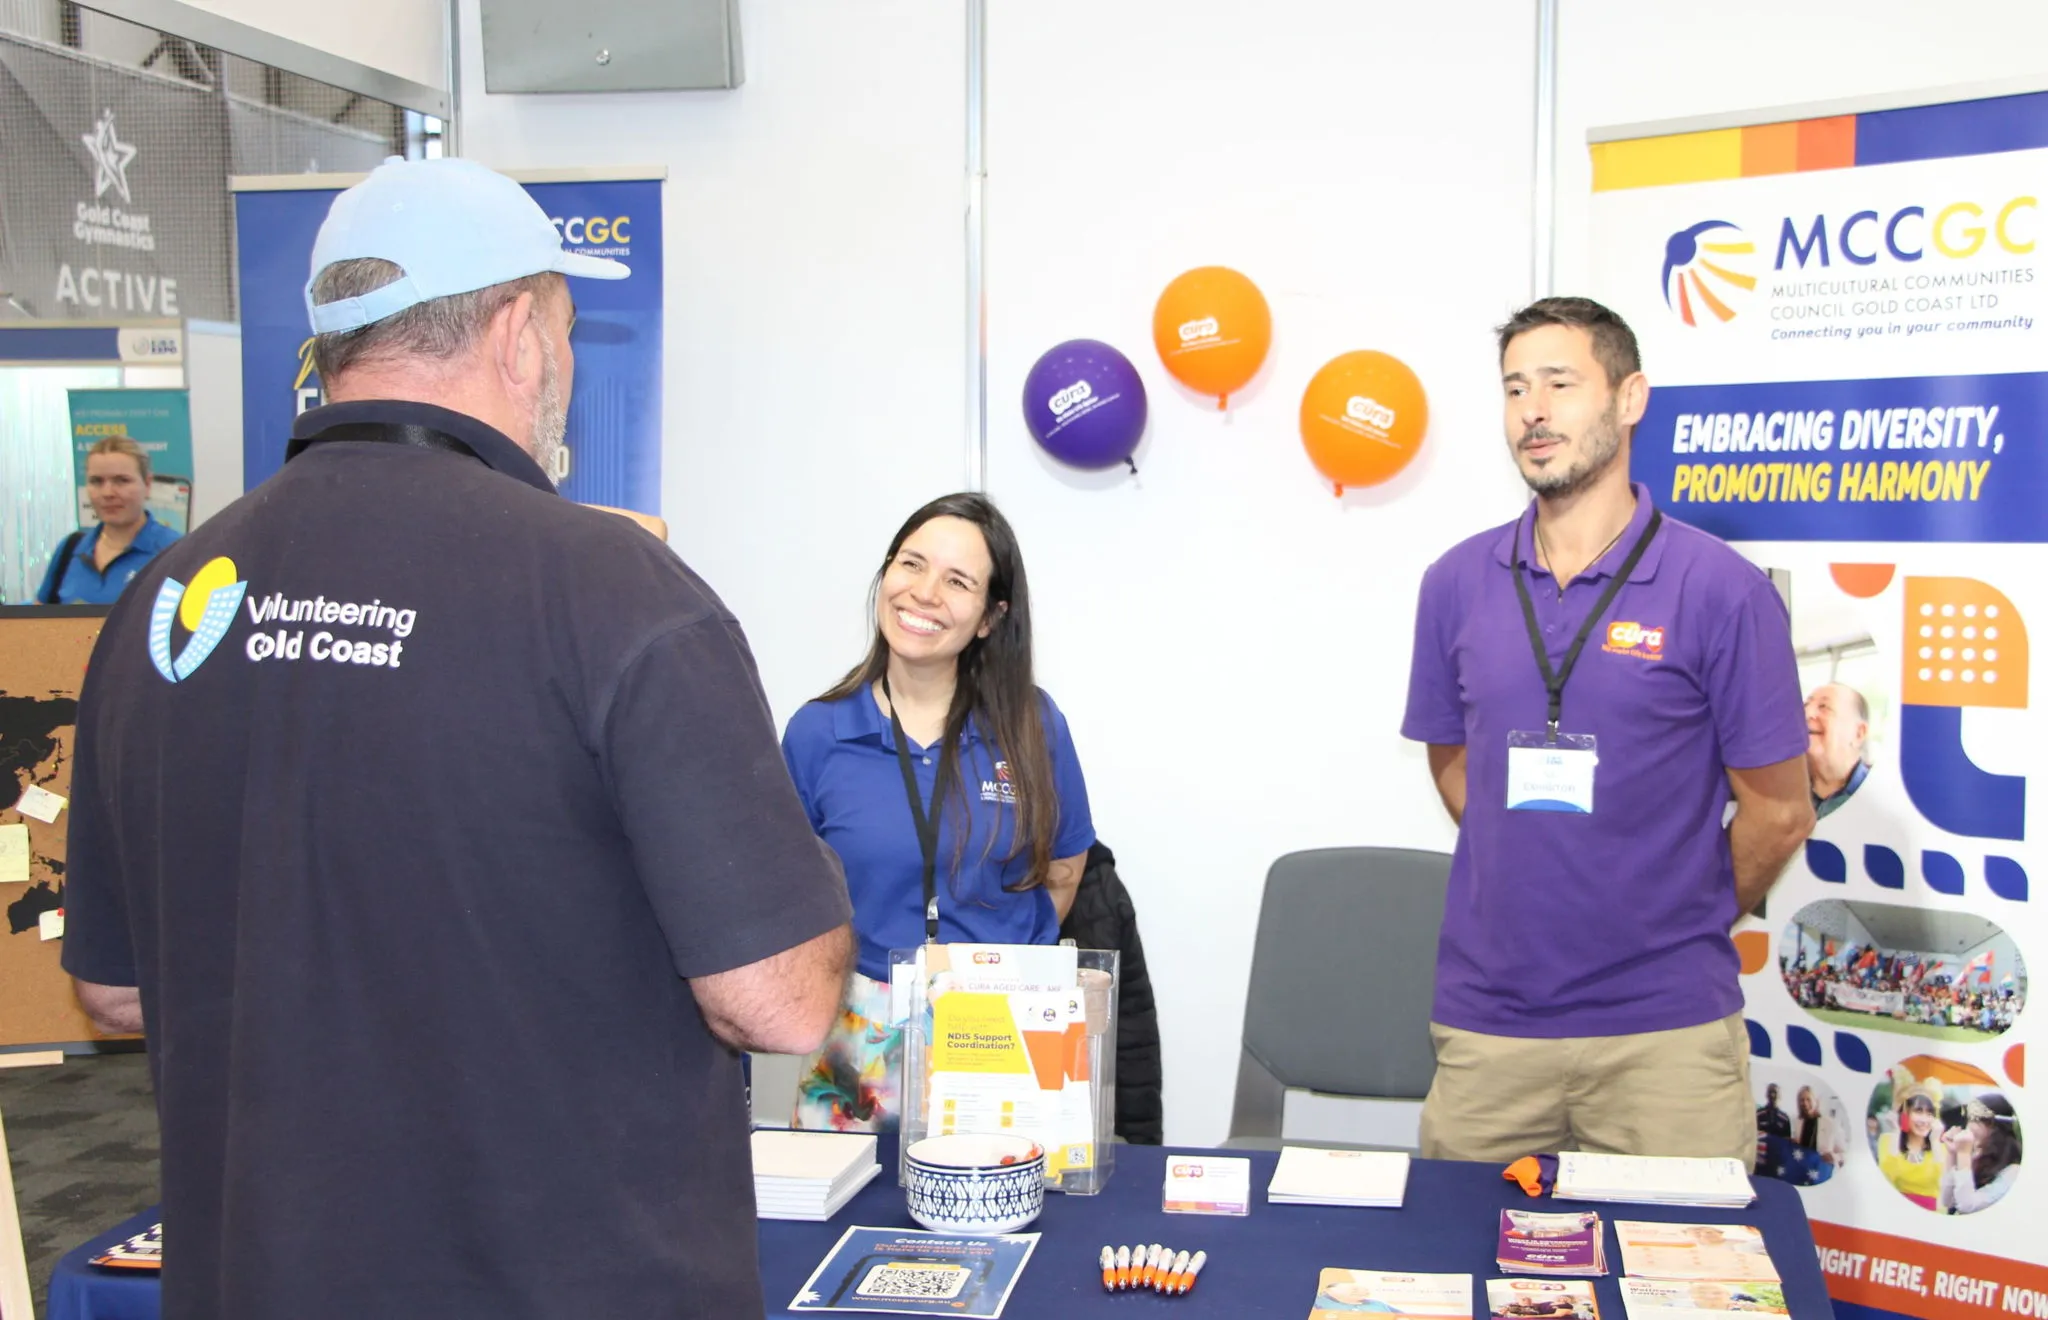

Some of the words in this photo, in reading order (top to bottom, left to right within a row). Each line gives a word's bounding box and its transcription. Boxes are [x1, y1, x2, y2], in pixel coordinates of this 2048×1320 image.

[1774, 195, 2037, 271] MCCGC
[56, 263, 179, 315] ACTIVE
[1771, 277, 1898, 298] MULTICULTURAL
[1904, 268, 2034, 290] COMMUNITIES
[1770, 302, 1845, 321] COUNCIL
[1852, 299, 1898, 317] GOLD
[1904, 296, 1963, 313] COAST
[1970, 294, 1998, 309] LTD
[1771, 325, 1851, 340] Connecting
[1857, 326, 1883, 338] you
[1888, 321, 1901, 334] in
[1906, 322, 1941, 336] your
[1946, 315, 2034, 332] community
[1672, 409, 1834, 453] EMBRACING
[1838, 405, 2004, 454] DIVERSITY,
[1672, 461, 1833, 502] PROMOTING
[1837, 460, 1991, 501] HARMONY
[247, 592, 417, 638] Volunteering
[246, 629, 304, 662] Gold
[309, 630, 403, 668] Coast
[946, 1041, 1015, 1050] Coordination?
[947, 1032, 970, 1040] NDIS
[973, 1033, 1012, 1042] Support
[895, 1238, 963, 1246] Contact
[1869, 1256, 1929, 1298] HERE,
[1933, 1270, 1999, 1308] RIGHT
